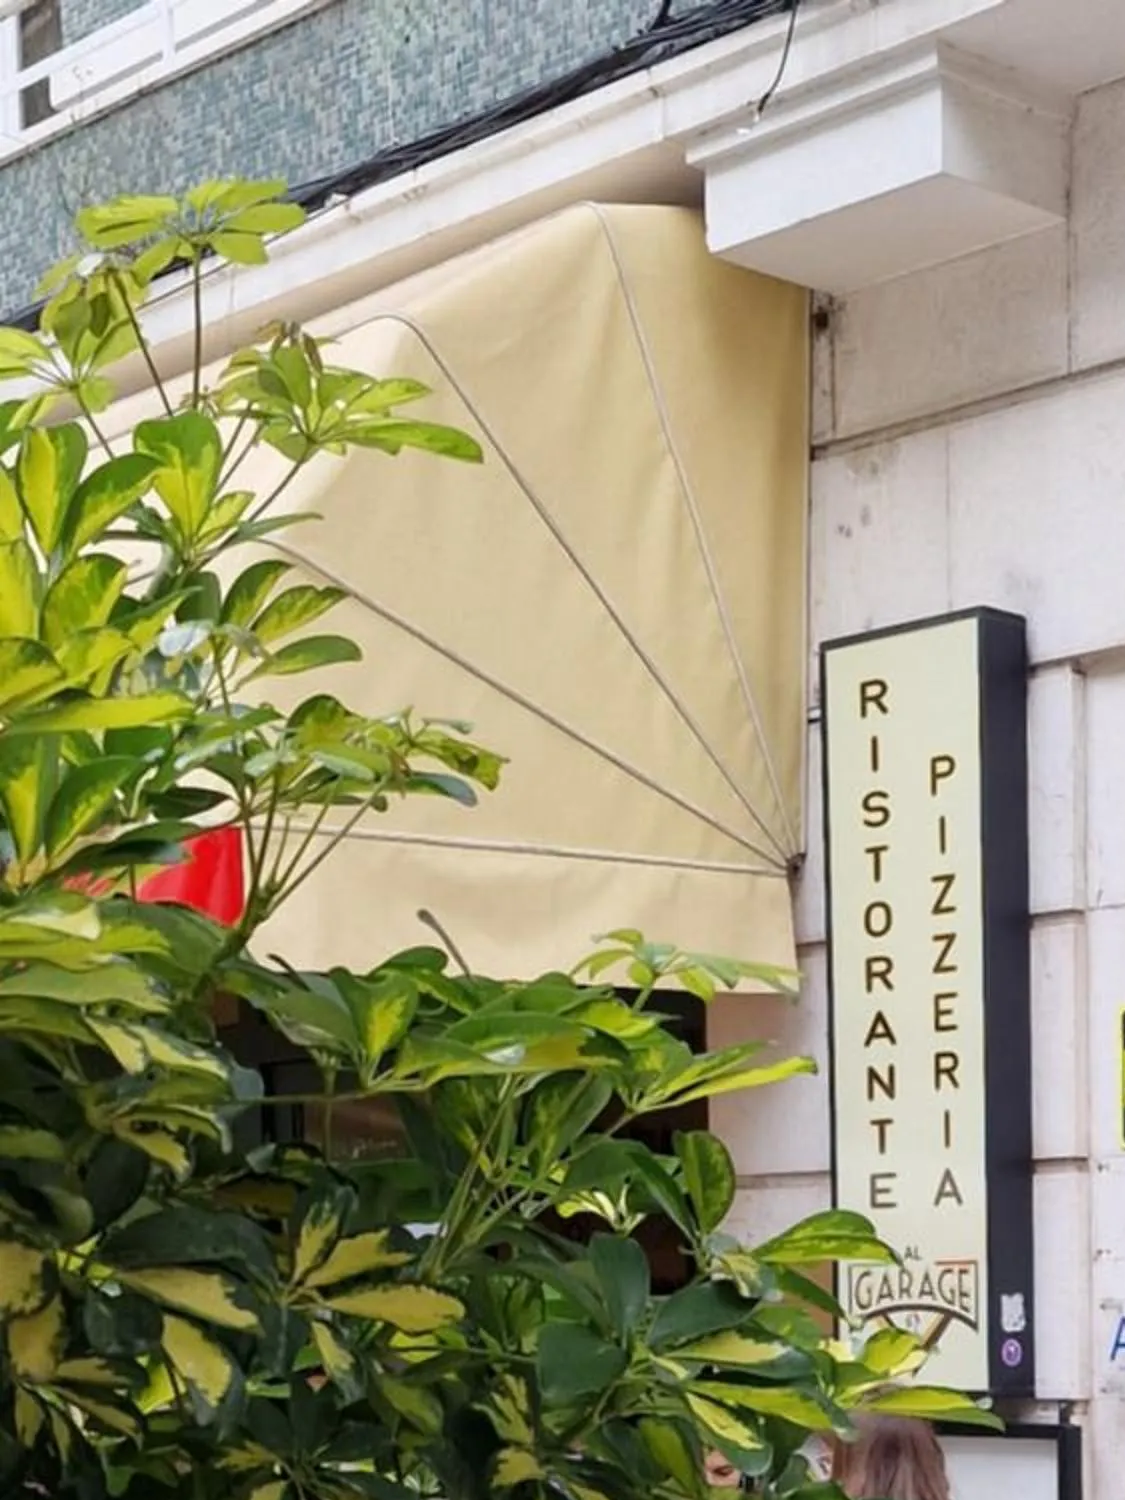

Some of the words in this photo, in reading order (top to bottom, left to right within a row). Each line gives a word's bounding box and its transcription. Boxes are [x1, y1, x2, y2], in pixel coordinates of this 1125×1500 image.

[859, 679, 898, 1210] RISTORANTE
[930, 754, 964, 1207] PIZZERIA
[854, 1267, 972, 1314] GARAGE
[904, 1246, 922, 1261] AL
